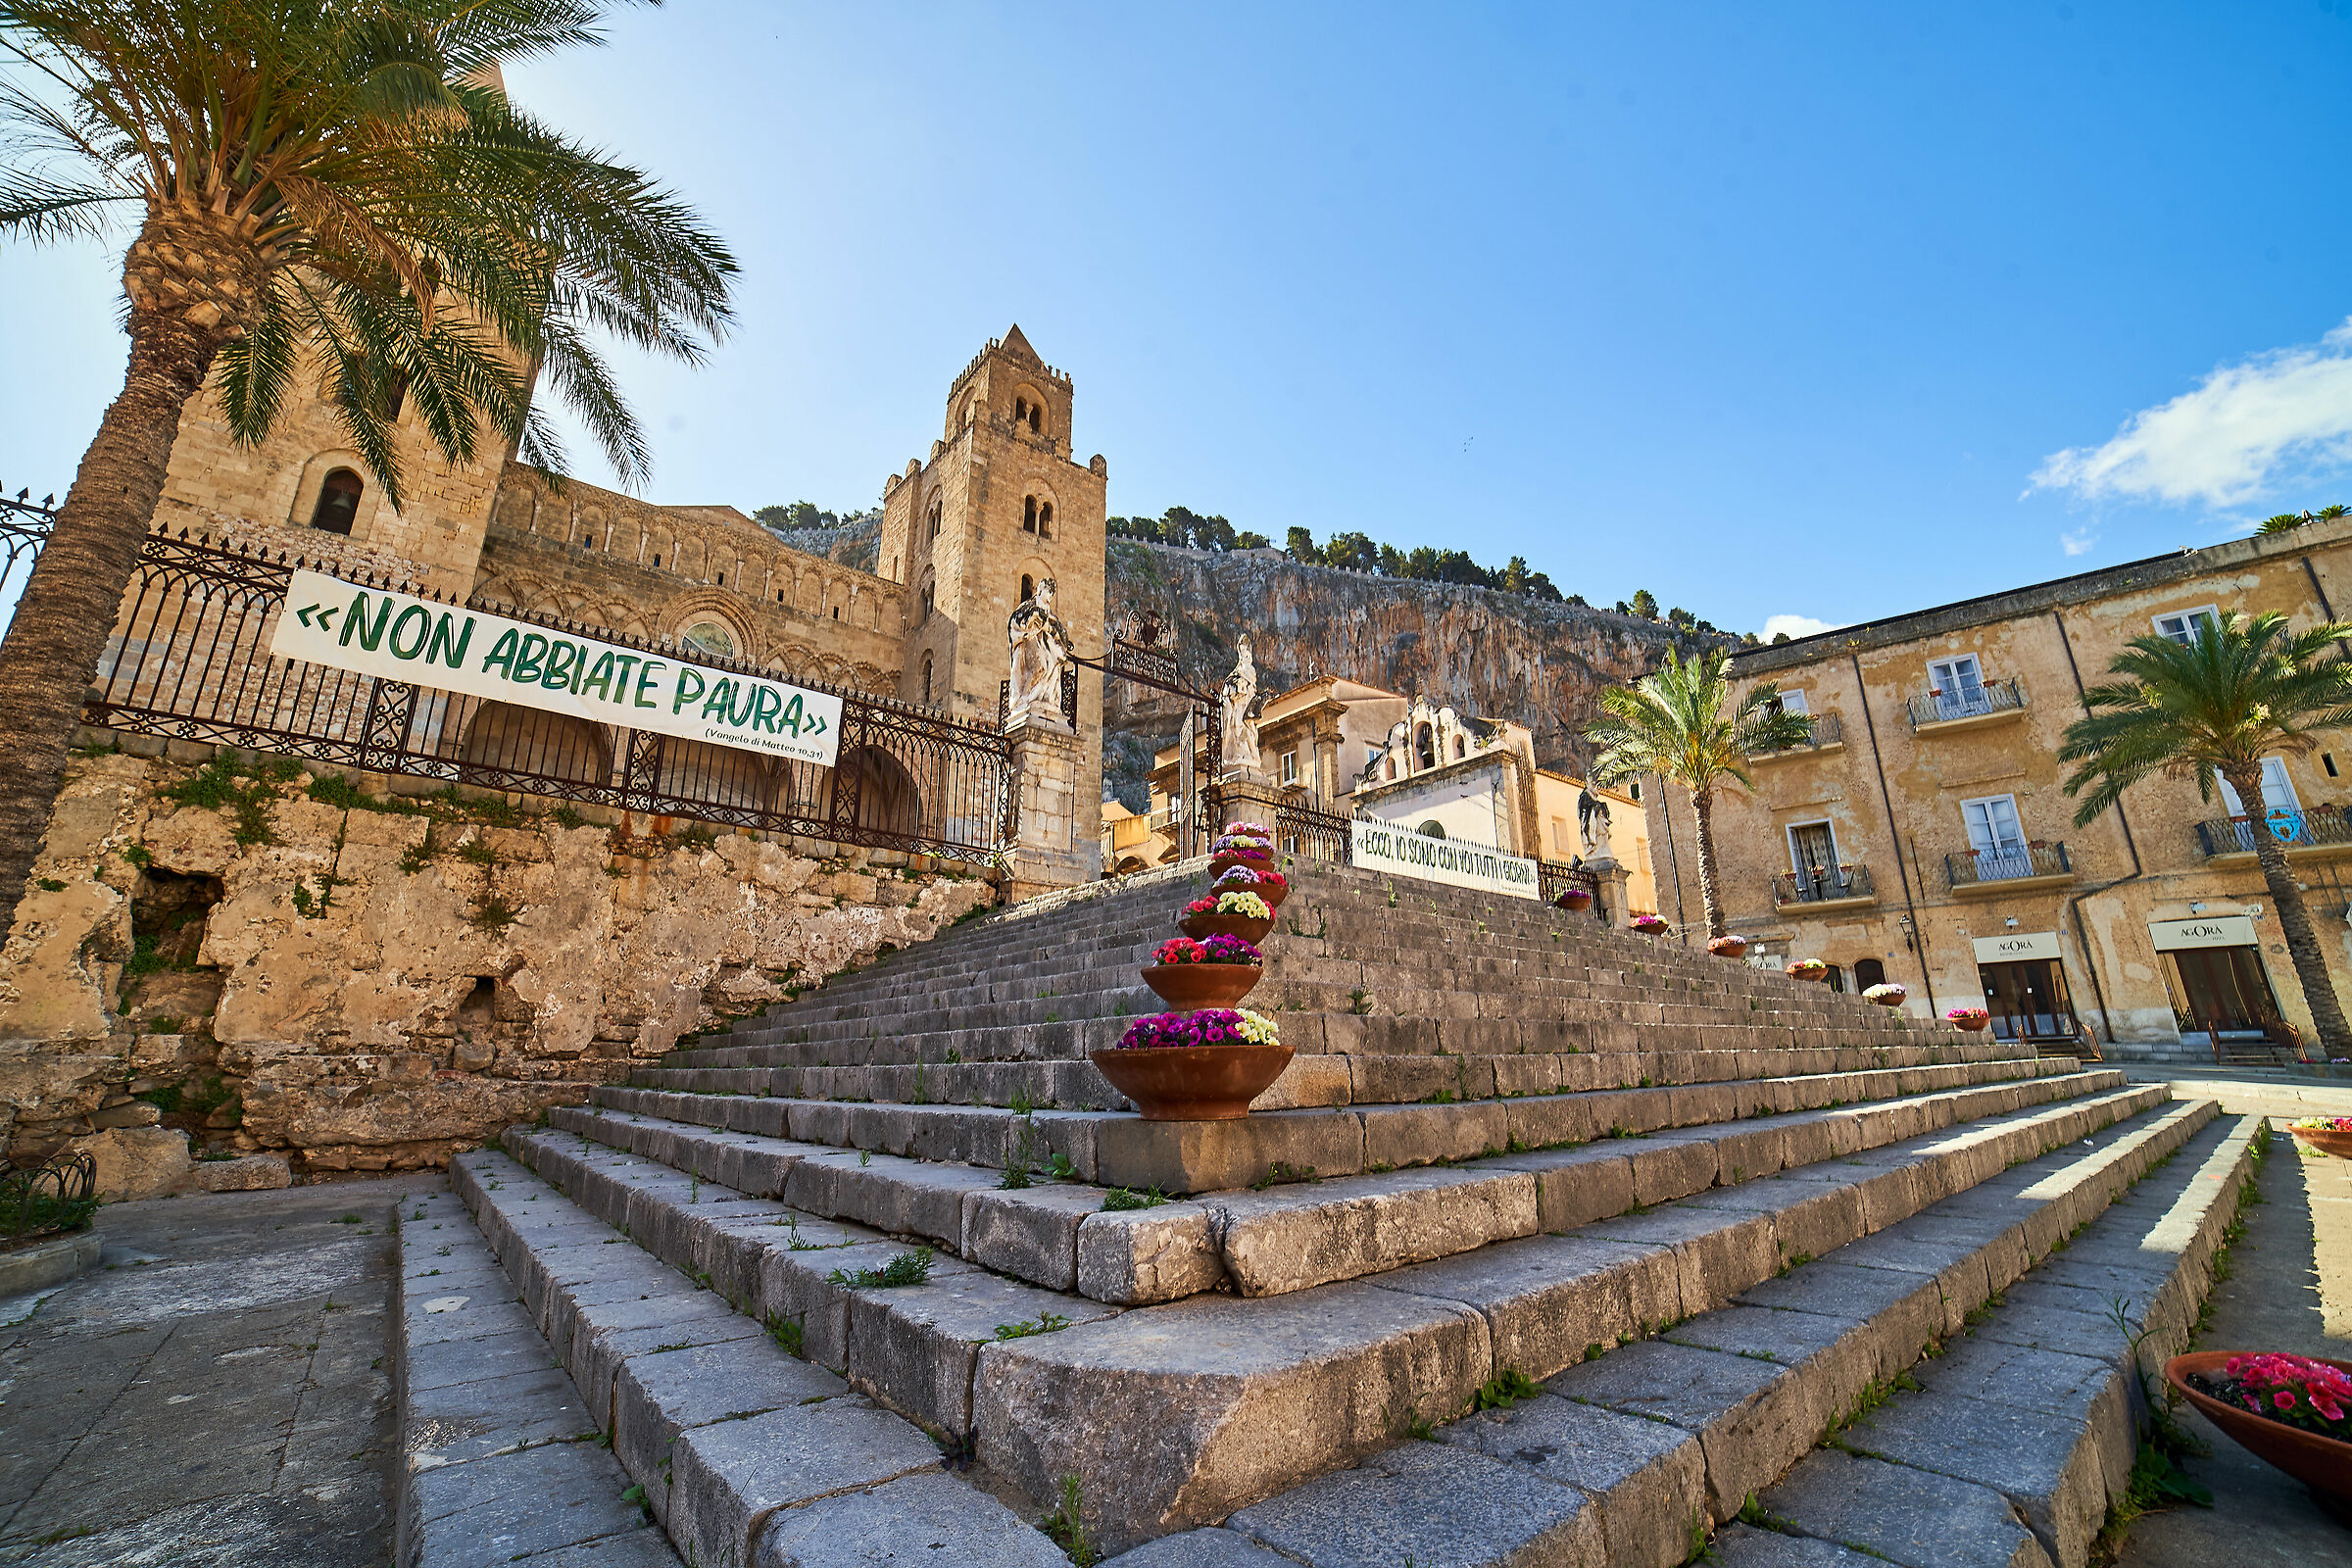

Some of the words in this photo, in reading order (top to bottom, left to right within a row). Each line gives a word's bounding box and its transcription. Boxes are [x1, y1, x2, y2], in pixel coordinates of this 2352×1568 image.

[481, 627, 667, 710] ABBIATE
[672, 666, 828, 739] PAURA»
[706, 727, 750, 744] (Vangelo
[751, 737, 760, 746] di
[761, 739, 796, 754] Matteo
[797, 748, 823, 760] 10,31)
[1396, 835, 1406, 862] IO
[1408, 837, 1437, 868] SONO
[1438, 845, 1458, 872] CON
[1457, 849, 1474, 875] VOI
[1473, 853, 1498, 879] TUTTI
